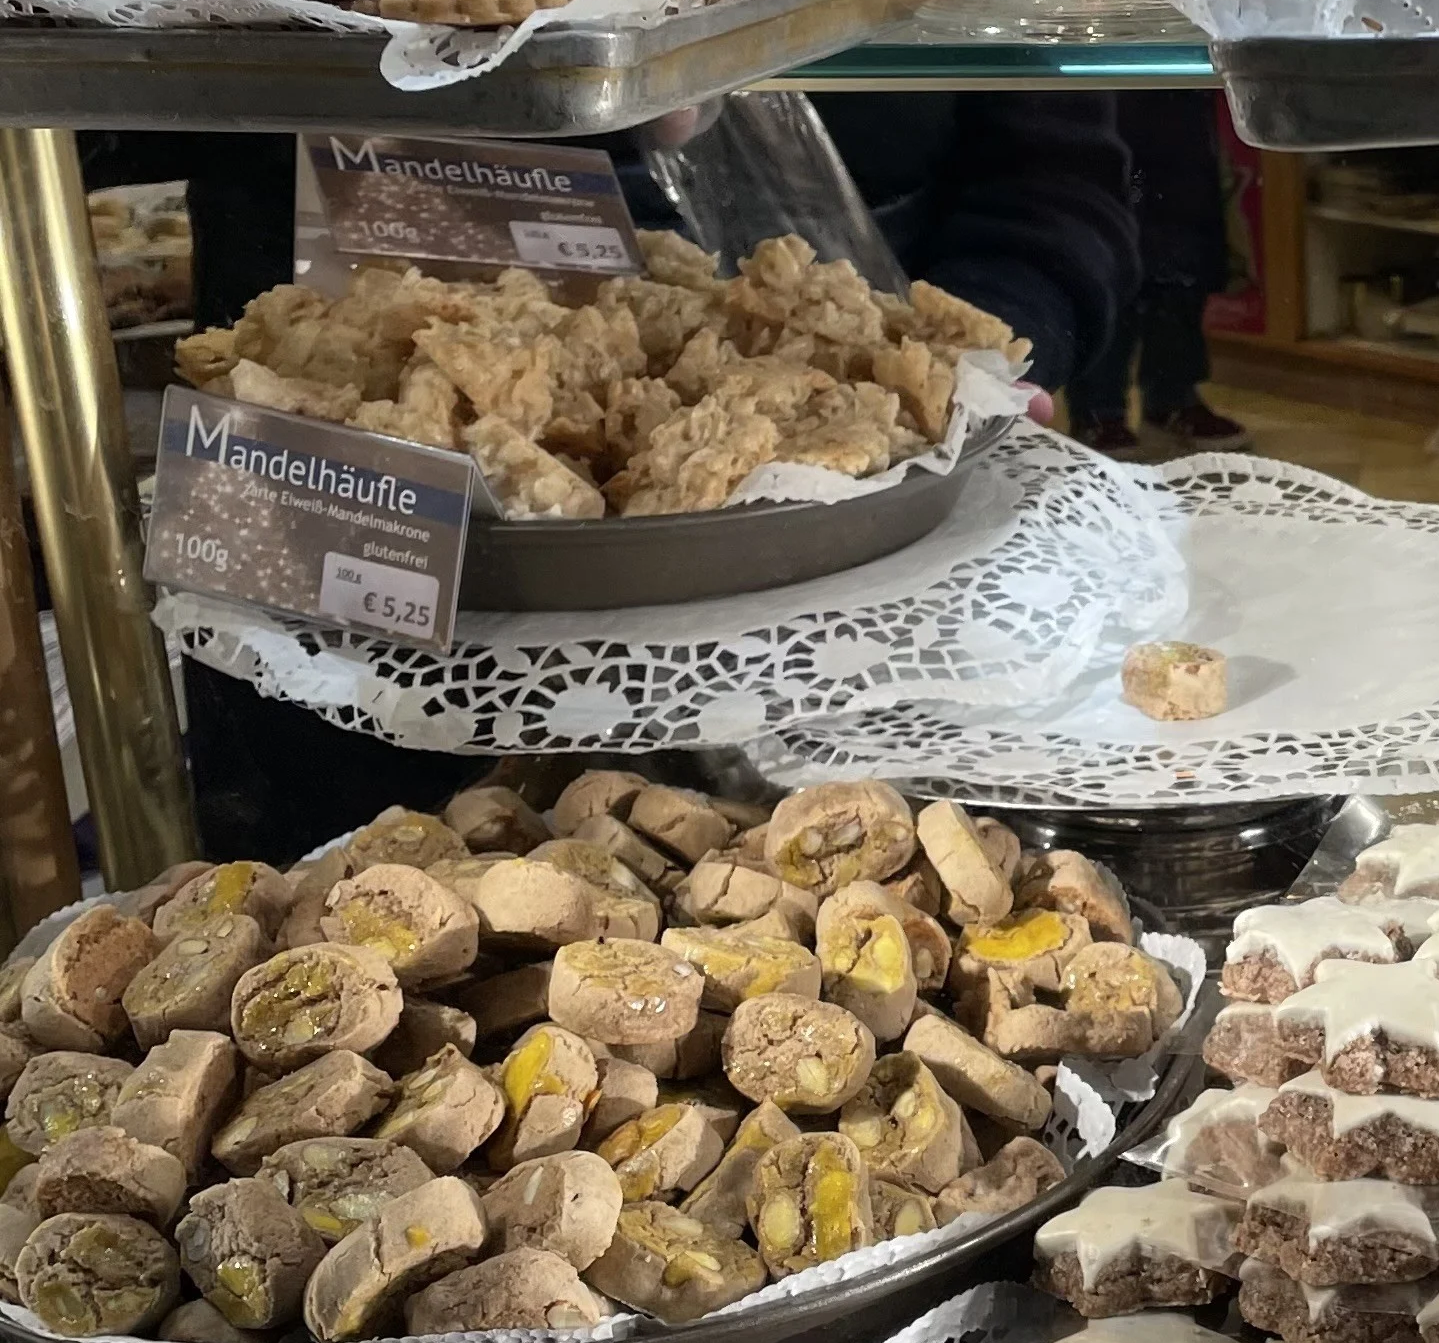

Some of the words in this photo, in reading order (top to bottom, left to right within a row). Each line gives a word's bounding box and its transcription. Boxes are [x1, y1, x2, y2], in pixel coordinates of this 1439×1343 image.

[330, 136, 572, 192] Mandelhäufle
[186, 404, 418, 515] Mandelhäufle
[174, 533, 229, 572] 100g
[363, 540, 429, 570] glutenfrei
[363, 591, 378, 613] €
[383, 596, 430, 627] 5,25
